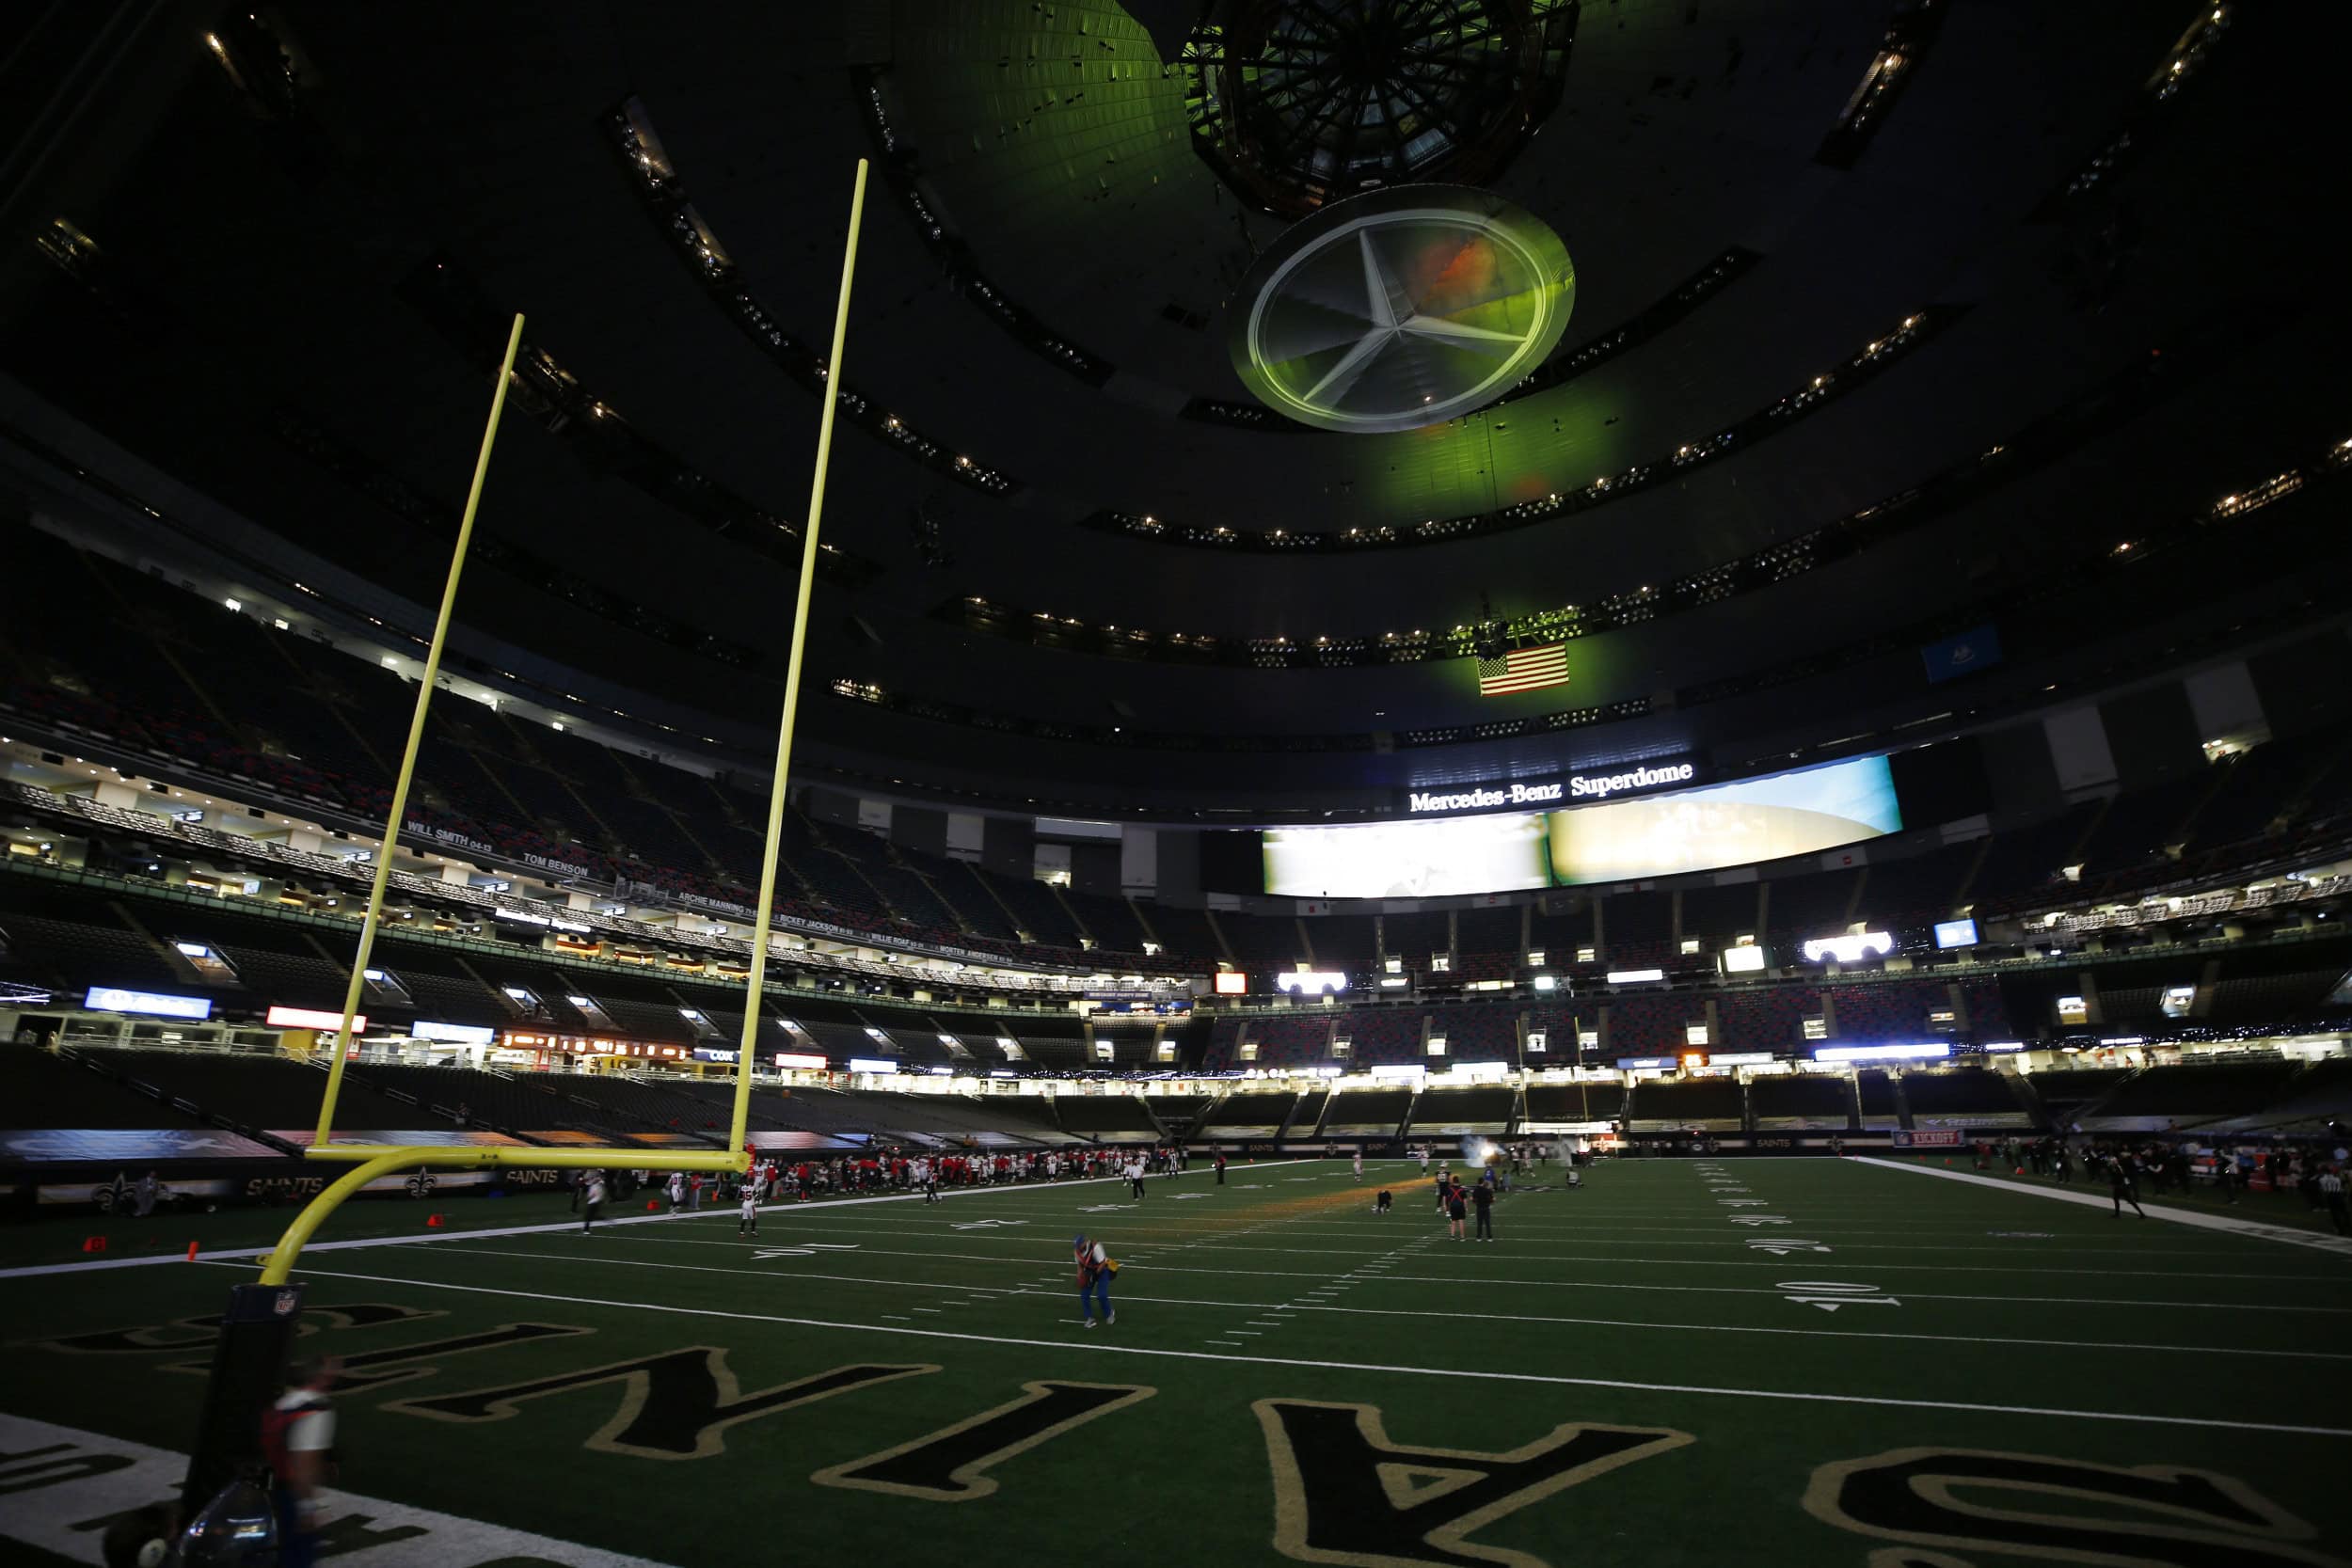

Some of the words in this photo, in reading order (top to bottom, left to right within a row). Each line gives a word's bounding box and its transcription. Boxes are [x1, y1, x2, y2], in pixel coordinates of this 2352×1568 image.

[1409, 783, 1562, 812] Mercedes-Benz
[1570, 764, 1692, 797] Superdome
[407, 820, 433, 836] WILL
[435, 829, 469, 846] SMITH
[523, 852, 547, 866] TOM
[548, 859, 589, 877] BENSON
[678, 892, 708, 905] ARCHIE
[708, 898, 744, 913] MANNING
[506, 1168, 559, 1184] SAINTS
